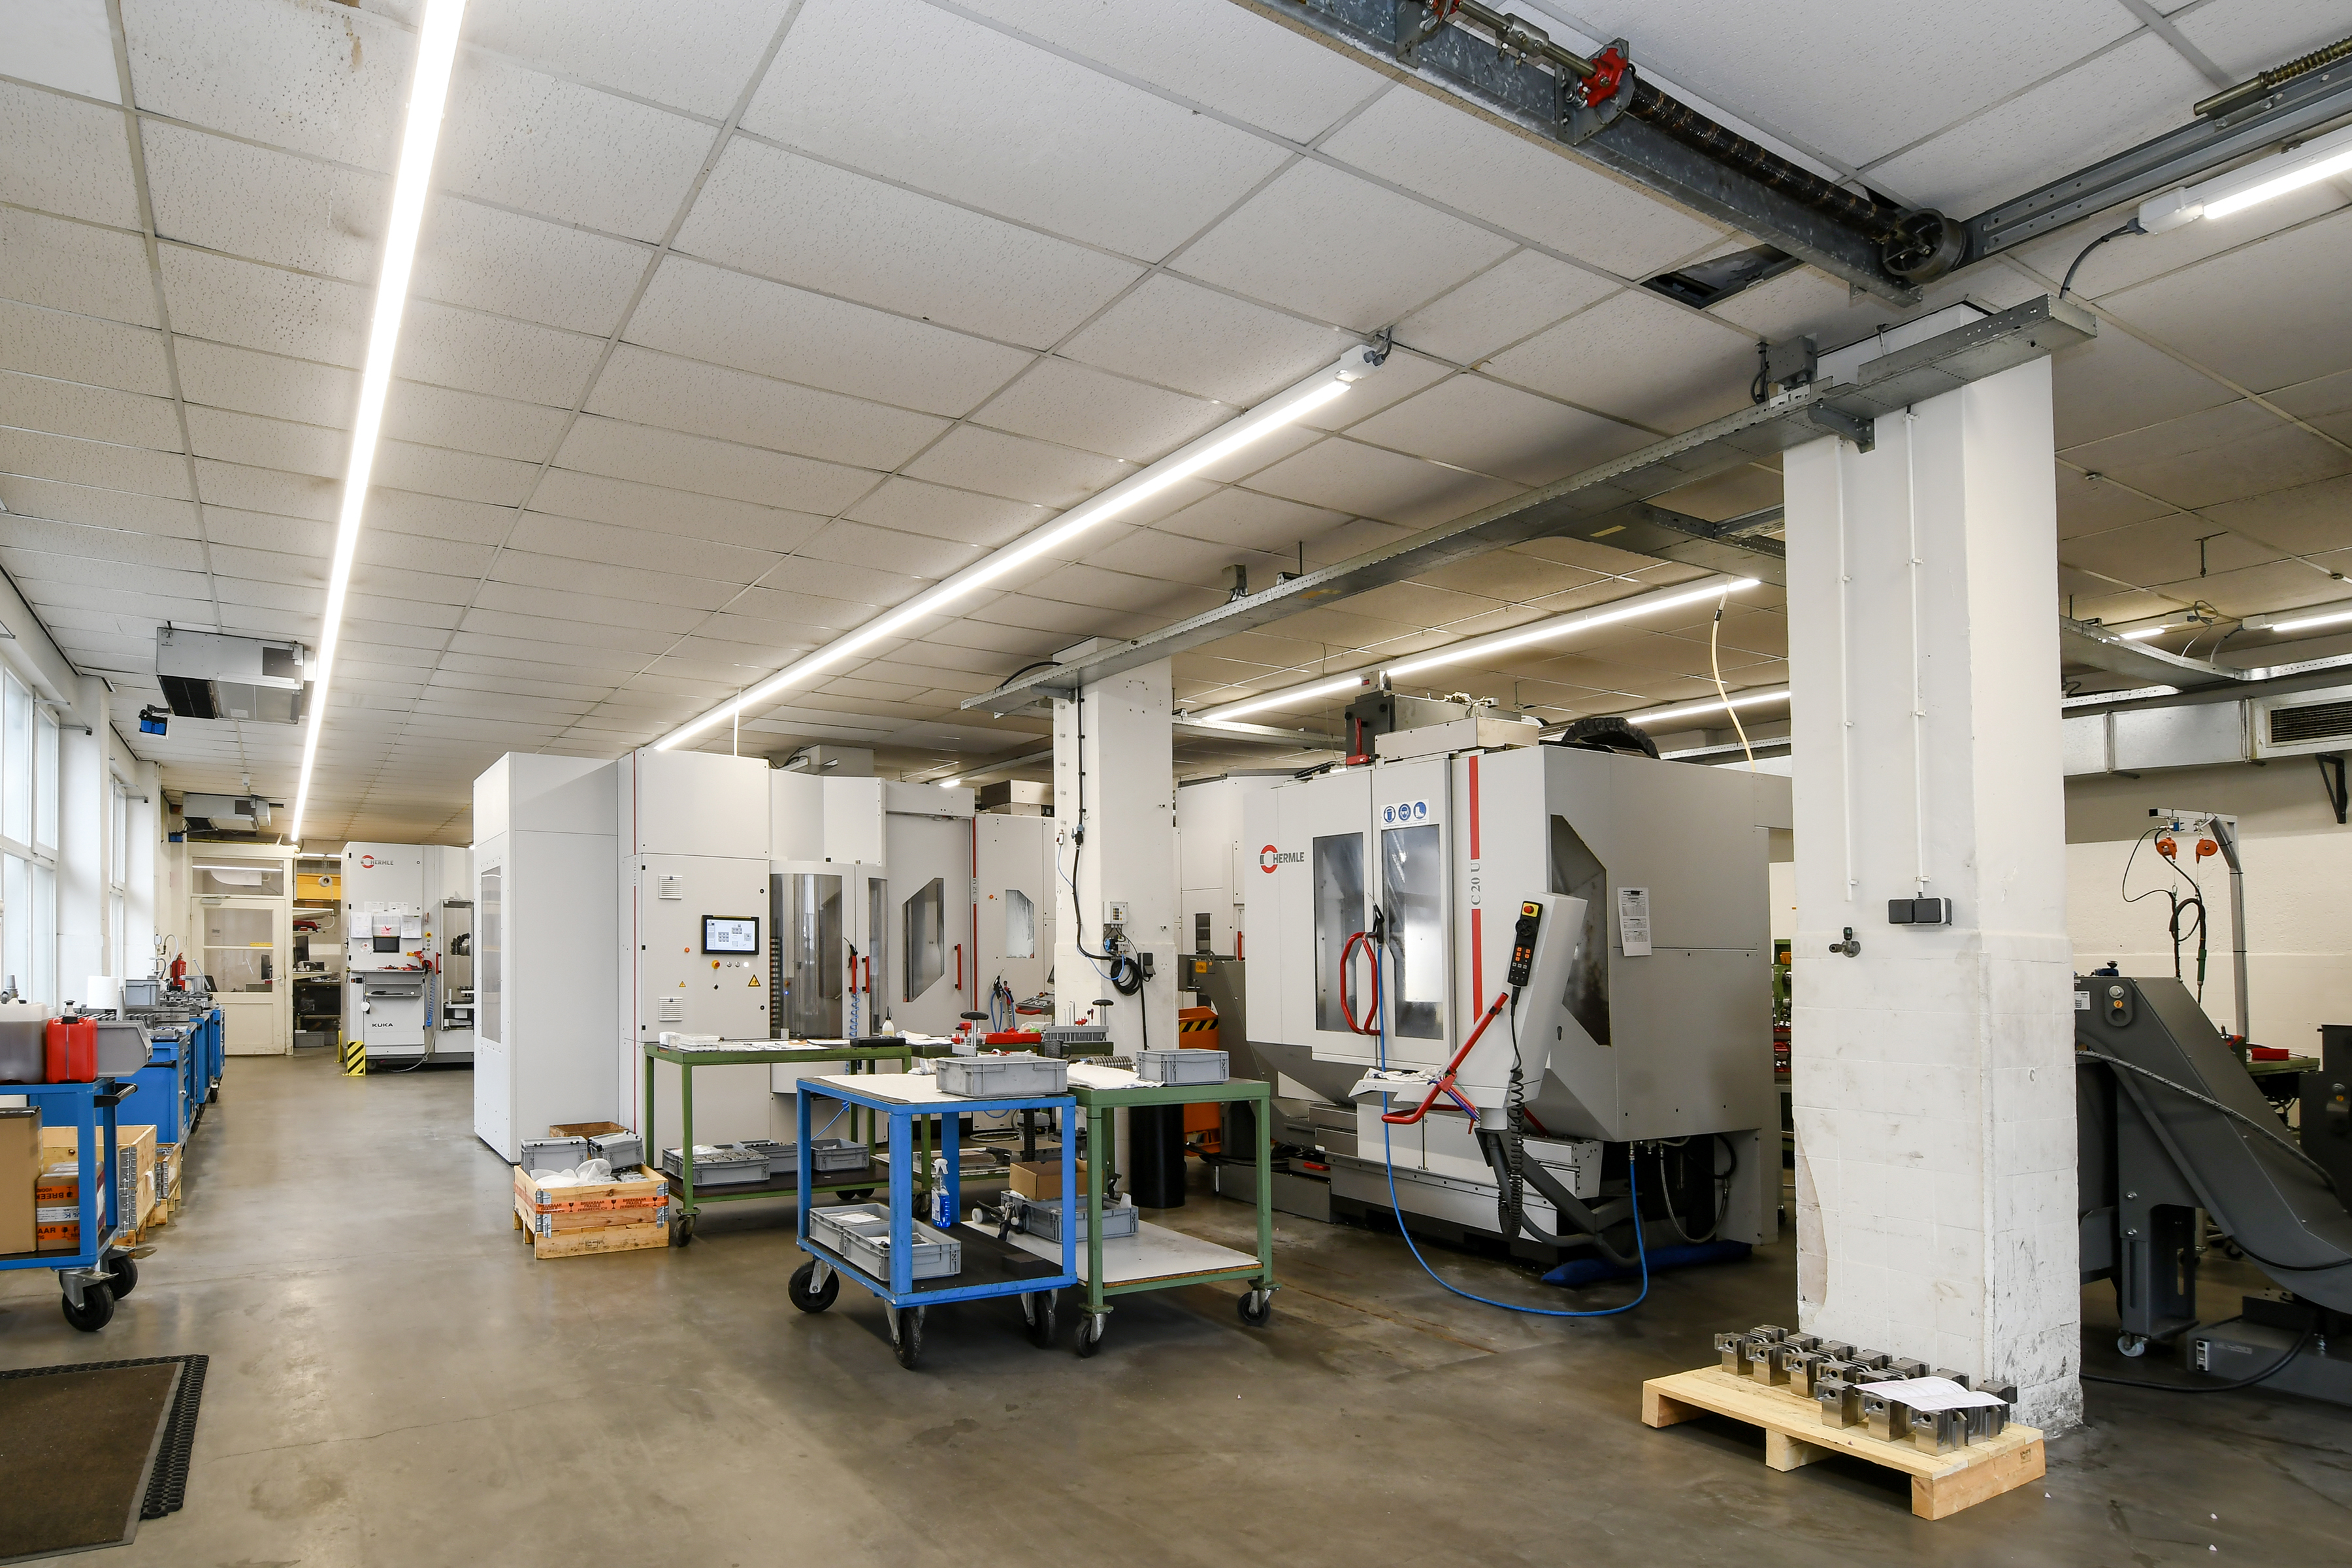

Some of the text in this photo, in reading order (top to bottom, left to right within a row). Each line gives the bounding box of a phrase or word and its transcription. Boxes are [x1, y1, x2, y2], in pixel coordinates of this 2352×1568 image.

[1273, 851, 1305, 864] HERMLE
[1471, 862, 1480, 873] U
[1471, 877, 1480, 892] 20
